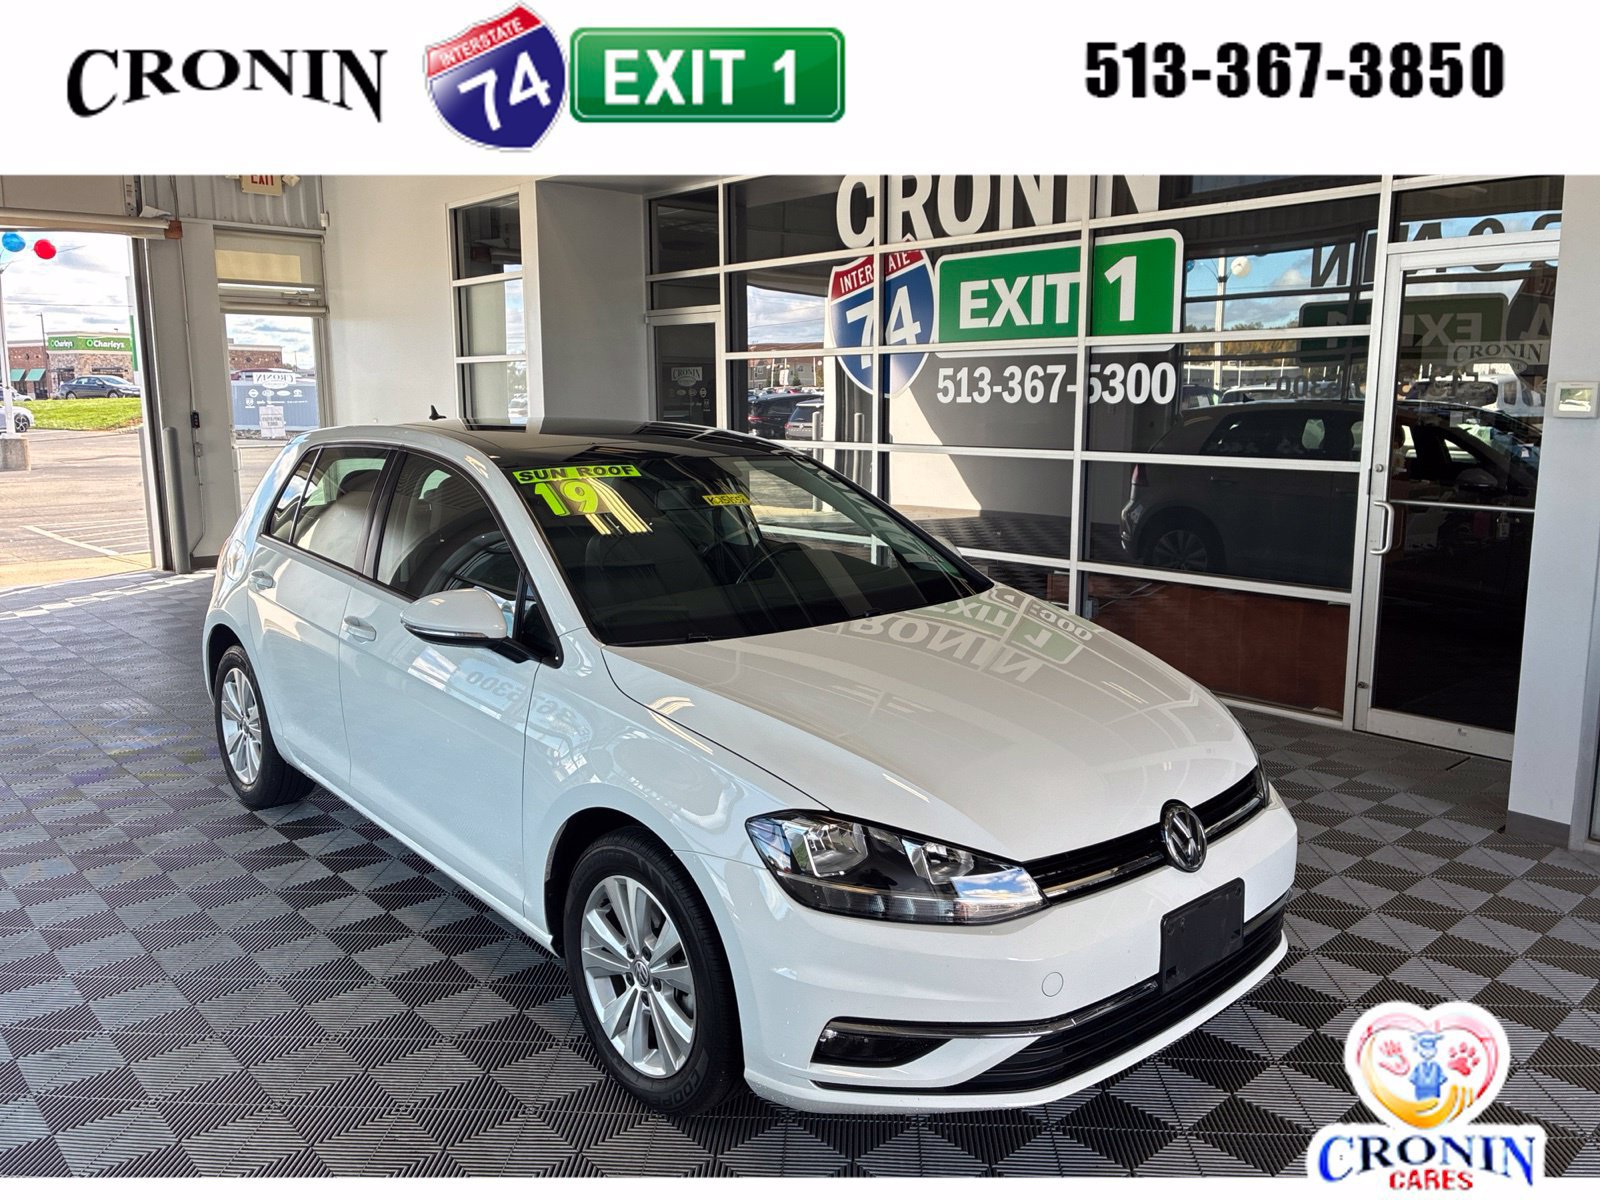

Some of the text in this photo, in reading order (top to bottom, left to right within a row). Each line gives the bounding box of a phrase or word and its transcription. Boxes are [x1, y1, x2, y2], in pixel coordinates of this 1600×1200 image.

[959, 256, 1137, 330] EXIT 1
[846, 285, 921, 370] 74
[1453, 343, 1544, 362] CRONIN
[518, 465, 634, 482] SUN ROOF
[534, 479, 599, 516] 19
